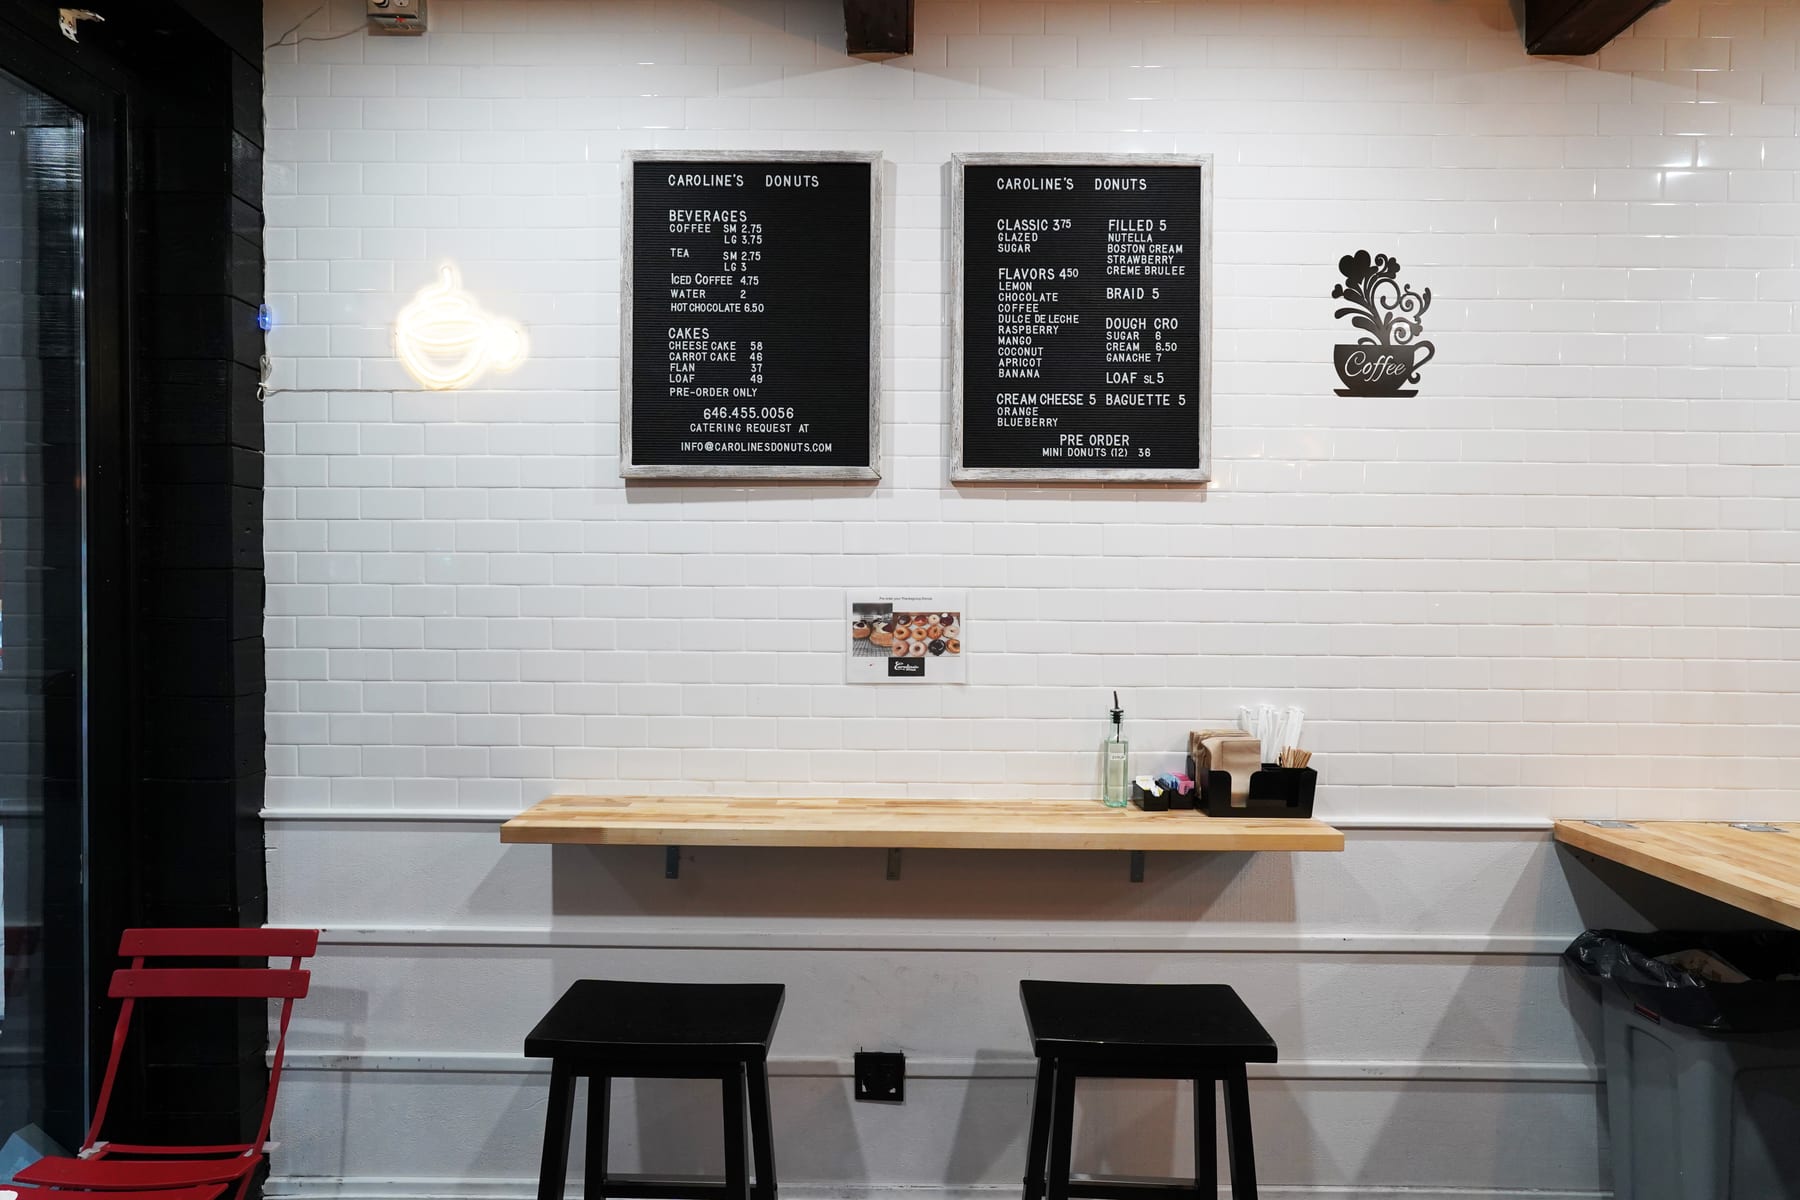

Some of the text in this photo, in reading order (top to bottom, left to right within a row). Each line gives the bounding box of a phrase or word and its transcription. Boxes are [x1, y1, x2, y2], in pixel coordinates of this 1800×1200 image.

[668, 174, 820, 188] CAROLINE'S DONUTS
[997, 177, 1147, 191] CAROLINE'S DONUTS
[669, 210, 747, 222] BEVERAGES
[669, 224, 762, 234] COFFEE SM 2.75
[997, 219, 1049, 231] CLASSIC
[1108, 219, 1167, 232] FILLED 5
[724, 235, 763, 245] LG 3.75
[997, 233, 1038, 242] GLAZED
[1108, 233, 1153, 243] NUTELLA
[997, 244, 1031, 253] SUGAR
[1107, 244, 1183, 254] BOSTON CREAM
[670, 248, 761, 261] TEA SM 2.75
[1107, 255, 1174, 265] STRAWBERRY
[724, 262, 747, 272] LG 3
[1106, 266, 1185, 275] CREME BRULEE
[998, 268, 1055, 280] FLAVORS
[740, 276, 759, 286] 4.75
[999, 282, 1033, 291] LEMON
[670, 289, 747, 299] WATER 2
[998, 292, 1059, 302] CHOCOLATE
[1106, 288, 1160, 300] BRAID 5
[670, 303, 764, 313] HOT CHOCOLATE 6.50
[998, 304, 1039, 313] COFFEE
[998, 314, 1079, 324] DULCE DE LECHE
[1106, 317, 1178, 330] DOUGH CRO
[668, 327, 710, 339] CAKES
[998, 325, 1059, 335] RASPBERRY
[998, 336, 1032, 345] MANGO
[1106, 331, 1162, 341] SUGAR 6
[668, 341, 763, 351] CHEESE CAKE 58
[1106, 342, 1178, 352] CREAM 6.50
[669, 352, 763, 362] CARROT CAKE 46
[998, 347, 1044, 357] COCONUT
[998, 358, 1043, 368] APRICOT
[1106, 353, 1162, 363] GANACHE 7
[670, 363, 763, 373] FLAN 37
[1344, 350, 1407, 382] Coffee
[998, 369, 1040, 378] BANANA
[1106, 372, 1164, 384] LOAF SL 5
[669, 374, 763, 384] LOAF 49
[669, 387, 758, 397] PRE-ORDER ONLY
[996, 393, 1096, 405] CREAM CHEESE 5
[1106, 394, 1186, 406] BAGUETTE 5
[703, 407, 794, 420] 646.455.0056
[997, 407, 1039, 416] ORANGE
[997, 417, 1058, 427] BLUEBERRY
[689, 423, 810, 433] CATERING REQUEST AT
[1060, 434, 1130, 446] PRE ORDER
[680, 441, 832, 453] INFO@CAROLINESDONUTS.COM
[1042, 448, 1151, 458] MINI DONUTS (12) 36
